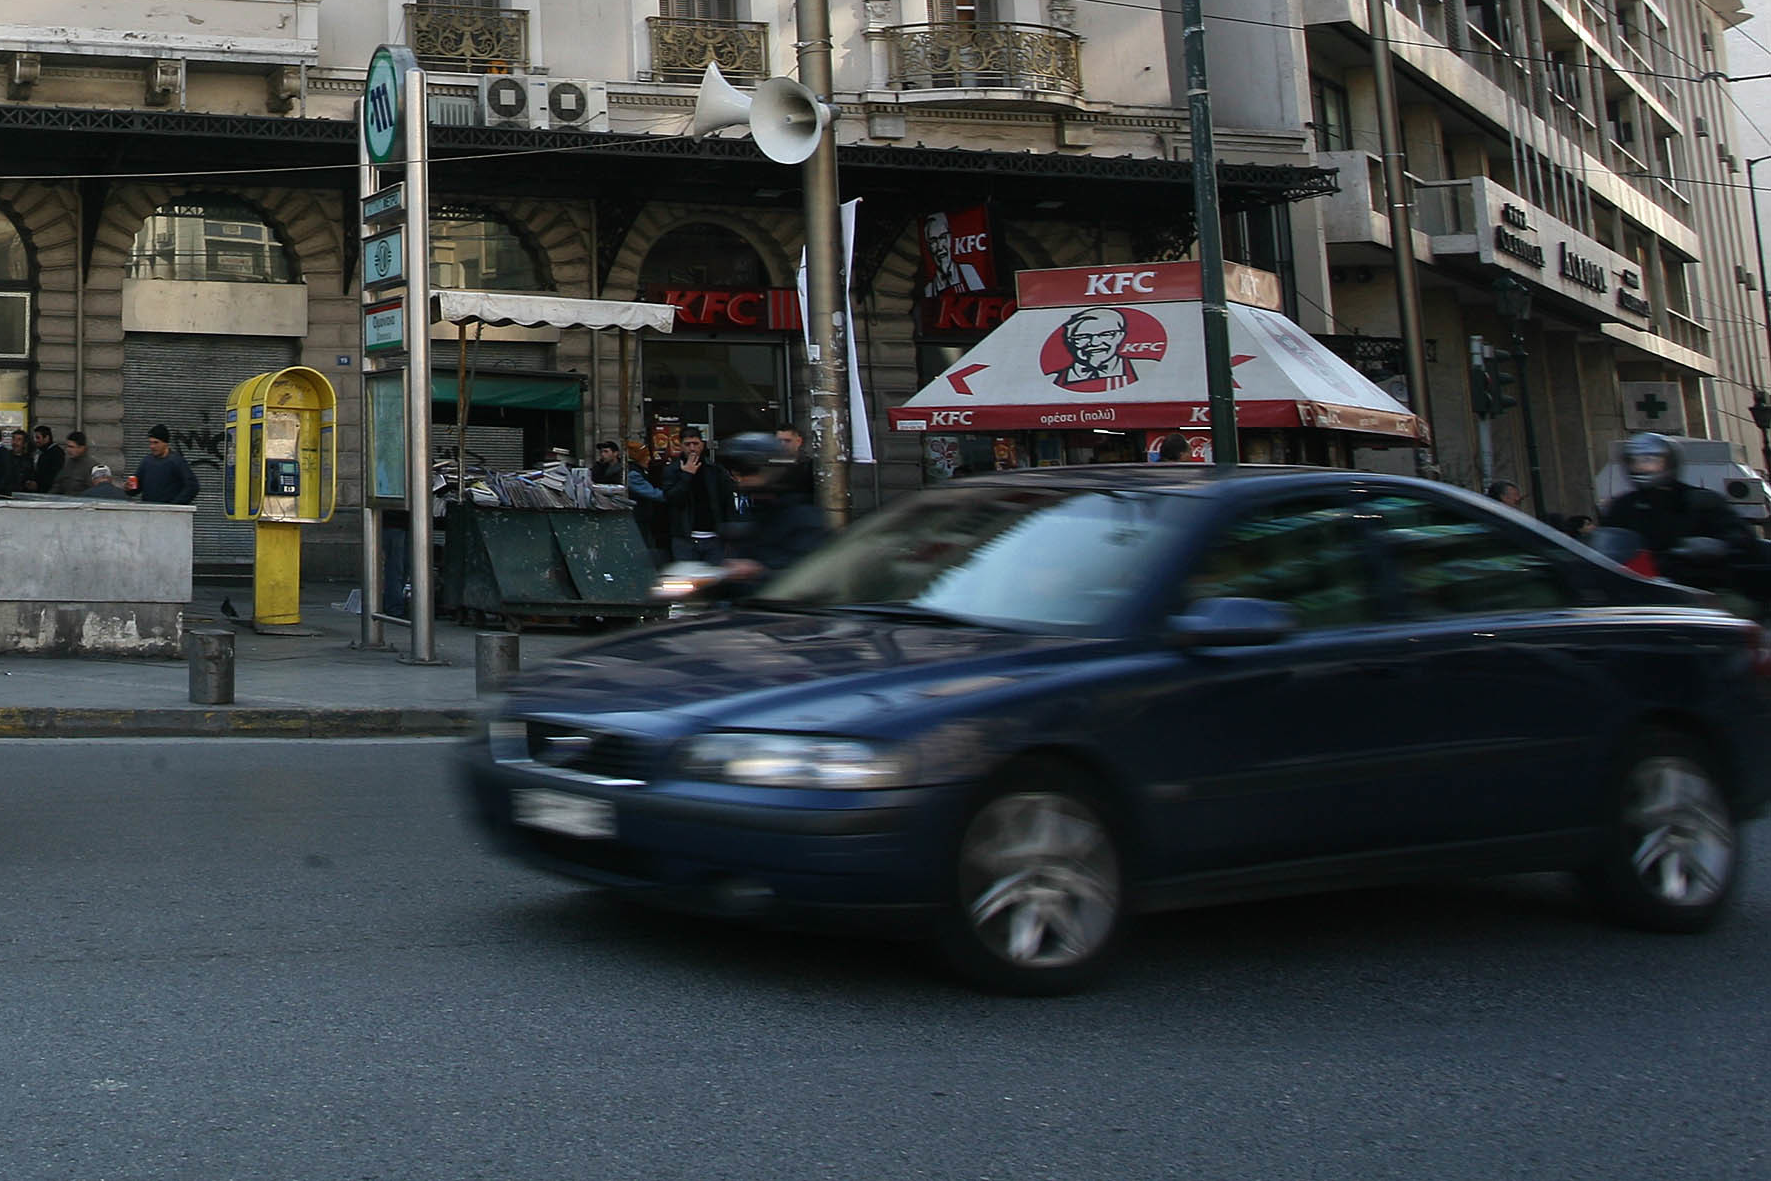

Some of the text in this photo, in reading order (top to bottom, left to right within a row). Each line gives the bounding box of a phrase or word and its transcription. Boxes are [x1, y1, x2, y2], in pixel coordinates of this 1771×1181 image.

[954, 232, 988, 256] KFC
[1084, 271, 1153, 296] KFC
[662, 289, 760, 326] KFC
[1121, 342, 1166, 353] KFC
[930, 411, 973, 425] KFC
